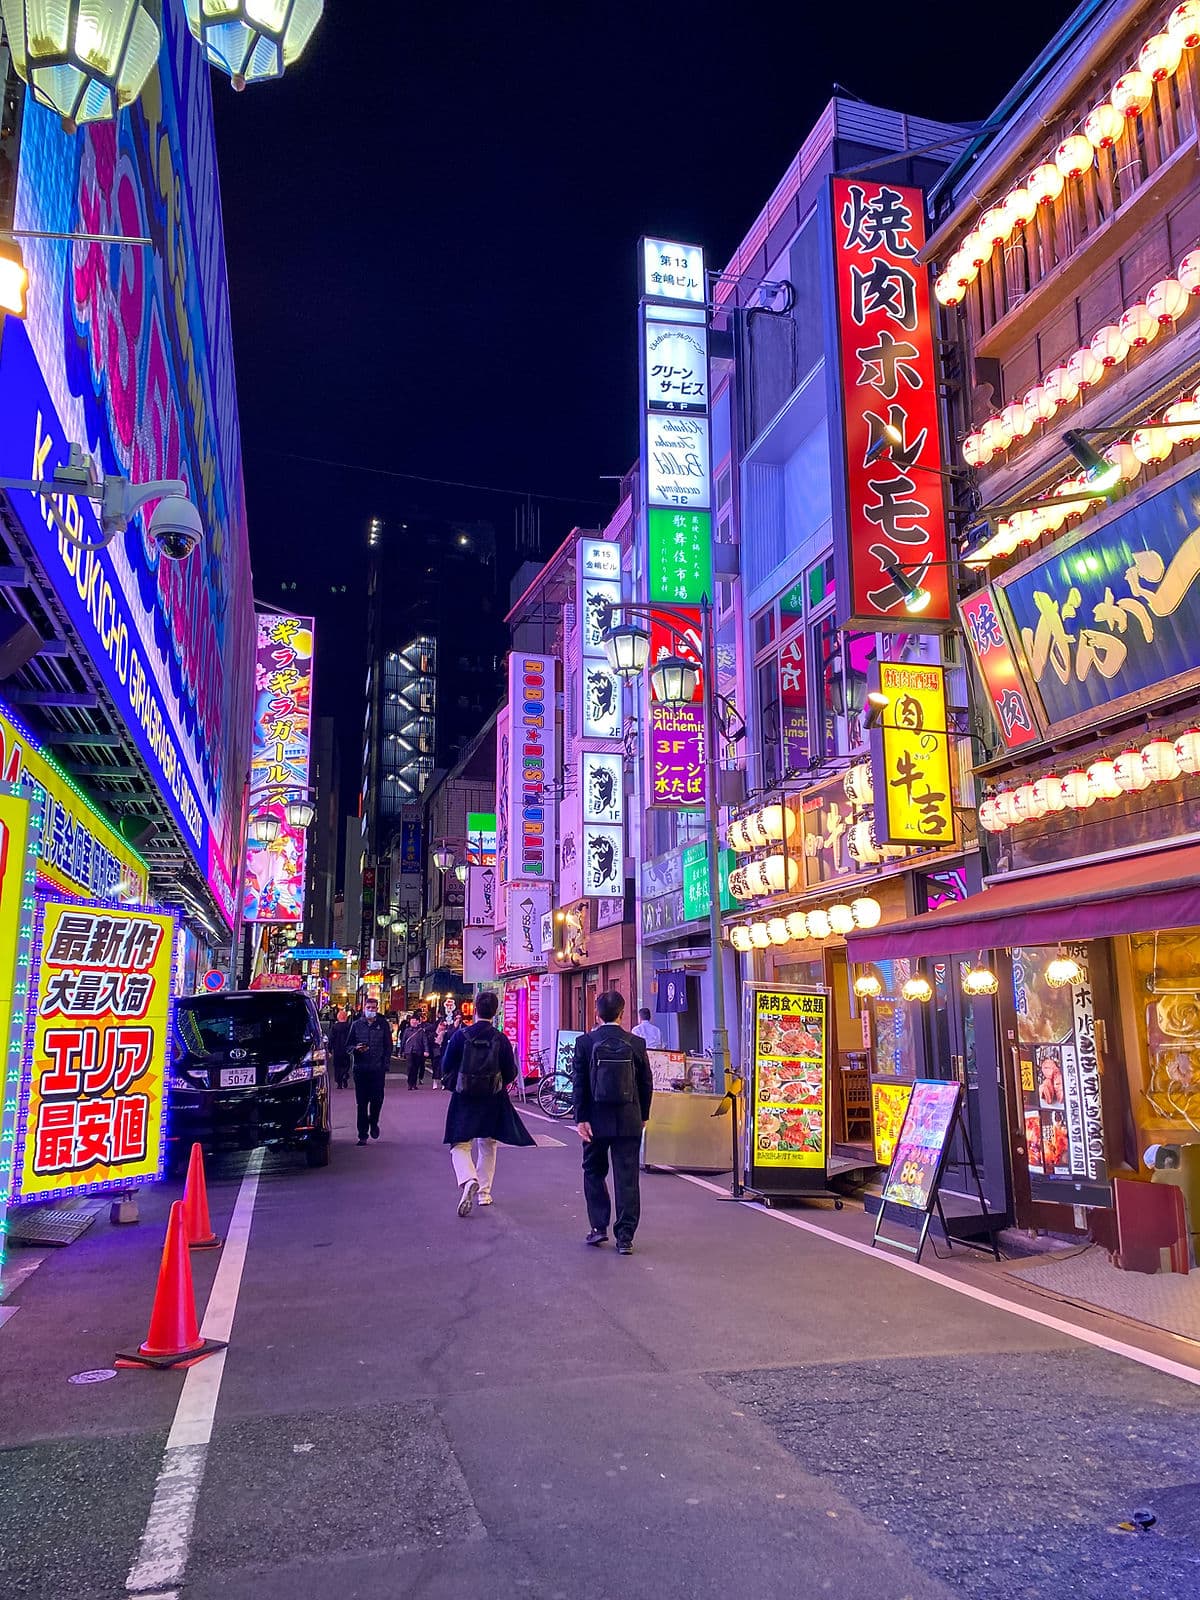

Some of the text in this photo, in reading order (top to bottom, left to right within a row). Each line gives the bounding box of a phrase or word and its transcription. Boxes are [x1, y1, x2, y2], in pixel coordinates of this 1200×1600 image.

[650, 271, 699, 289] 金嶋ビル
[651, 364, 694, 380] クリーン
[660, 380, 705, 396] サービス
[842, 185, 933, 613] 焼肉ホルモン
[672, 514, 688, 600] 歌舞伎市場
[969, 603, 1031, 737] 焼肉
[884, 669, 939, 691] 焼肉酒場
[522, 659, 545, 735] ROBOT
[268, 618, 301, 805] ギラギラガールズ
[653, 708, 695, 721] Shisha
[609, 727, 621, 737] 2F
[653, 720, 705, 733] Alchemis
[656, 740, 686, 754] 3F
[656, 762, 703, 777] シーシ
[655, 778, 702, 793] 水たば
[608, 810, 620, 820] 1F
[610, 884, 621, 893] B1
[47, 913, 162, 971] 最新作
[42, 972, 155, 1018] 大量入荷
[758, 994, 824, 1014] 焼肉食べ放題
[40, 1027, 153, 1097] エリア
[35, 1097, 148, 1172] 最安値
